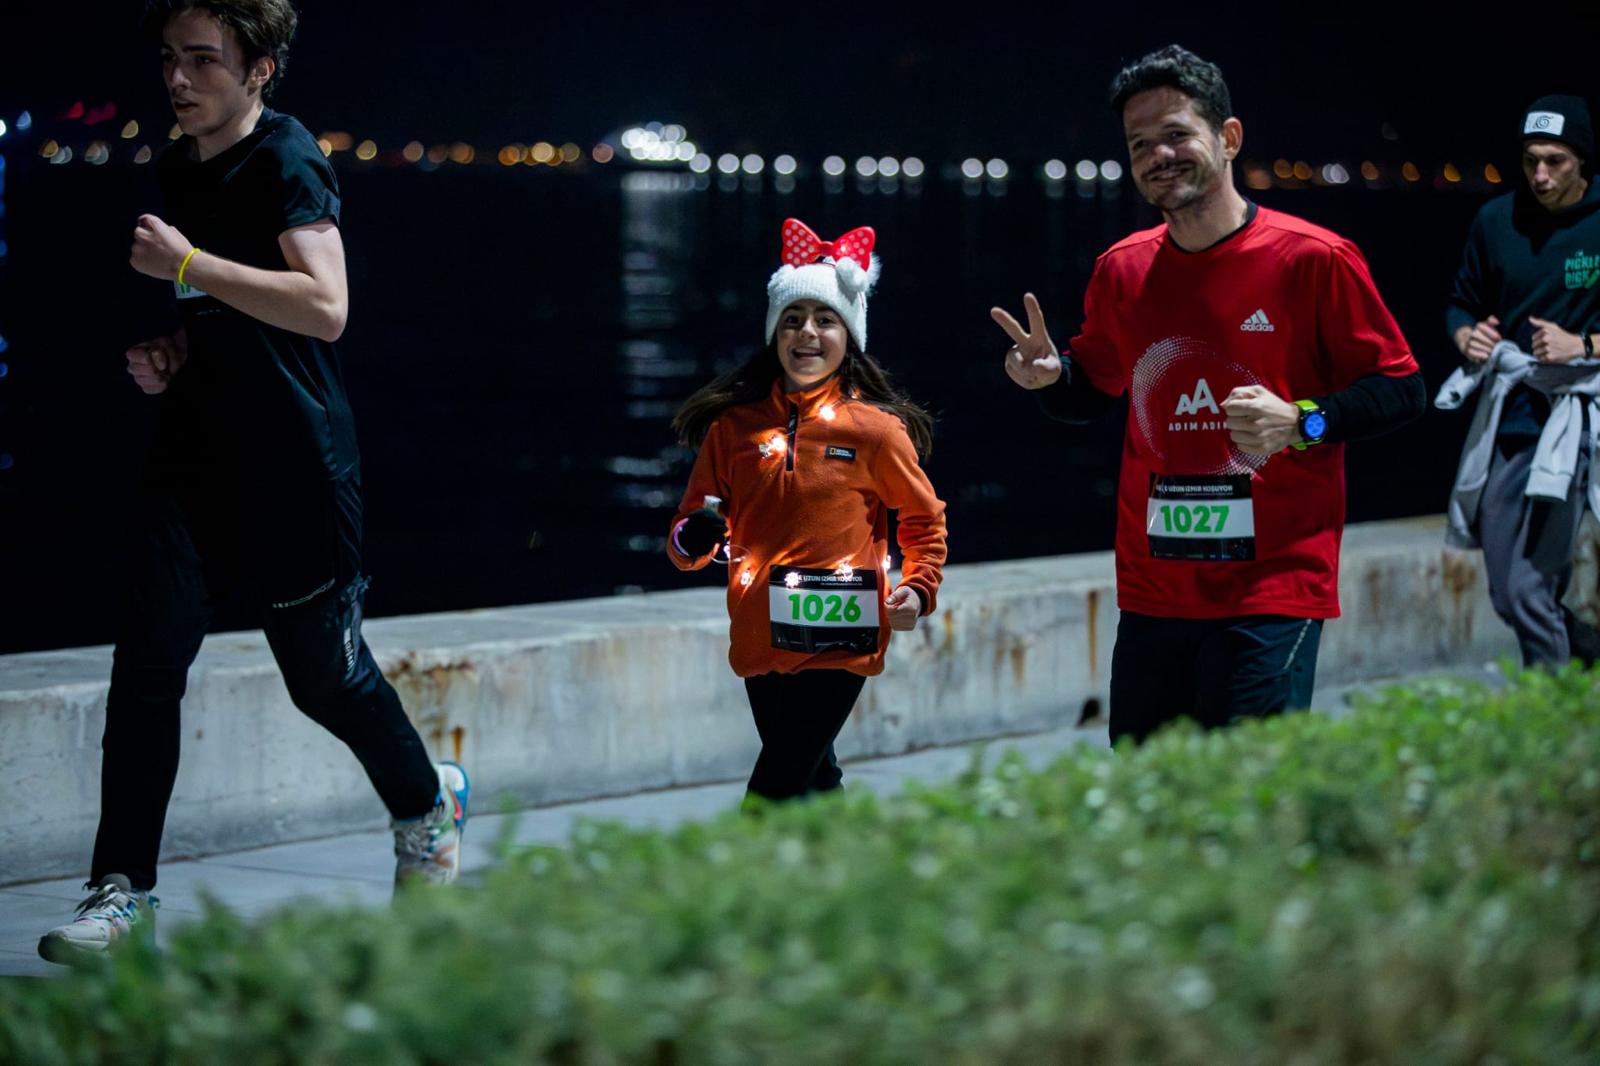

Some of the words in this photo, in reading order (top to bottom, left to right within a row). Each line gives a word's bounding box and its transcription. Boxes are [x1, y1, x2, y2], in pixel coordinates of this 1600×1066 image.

[1240, 323, 1275, 332] adidas
[1168, 421, 1198, 431] ADIM
[1160, 505, 1230, 533] 1027
[788, 593, 862, 623] 1026
